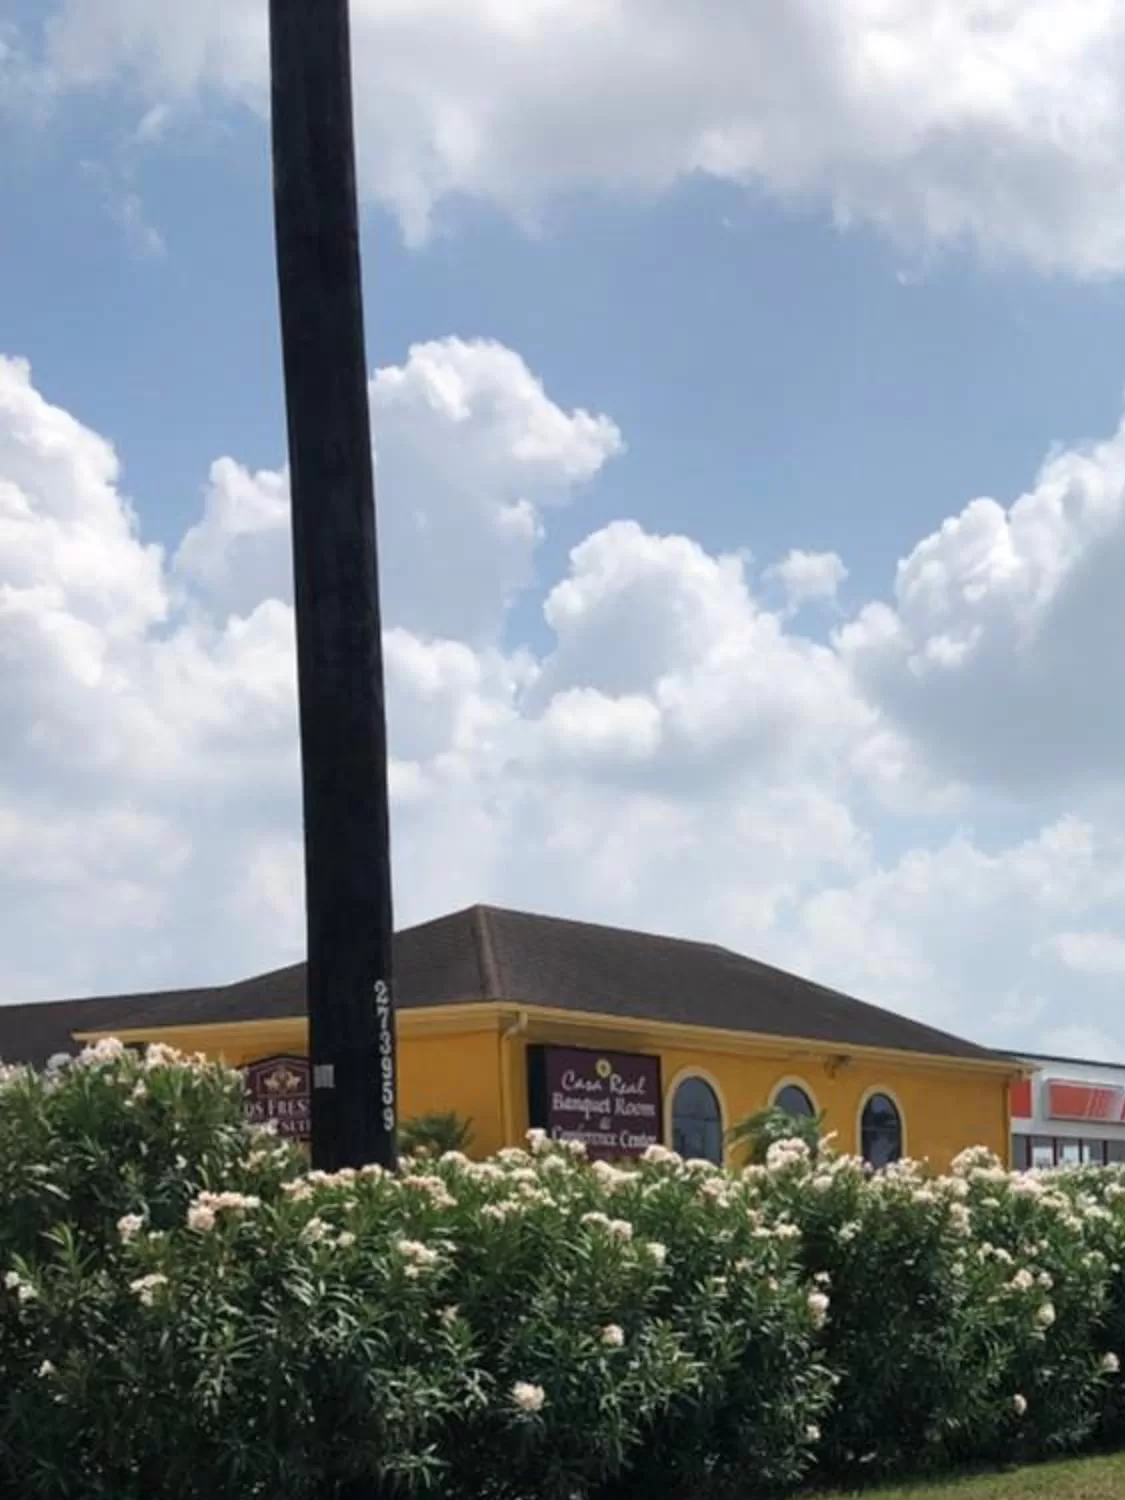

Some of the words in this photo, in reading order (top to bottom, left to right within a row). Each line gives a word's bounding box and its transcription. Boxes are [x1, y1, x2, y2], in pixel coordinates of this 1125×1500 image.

[561, 1069, 602, 1092] Casa
[609, 1073, 646, 1096] Real
[552, 1092, 611, 1120] Banquet
[614, 1097, 656, 1117] Room
